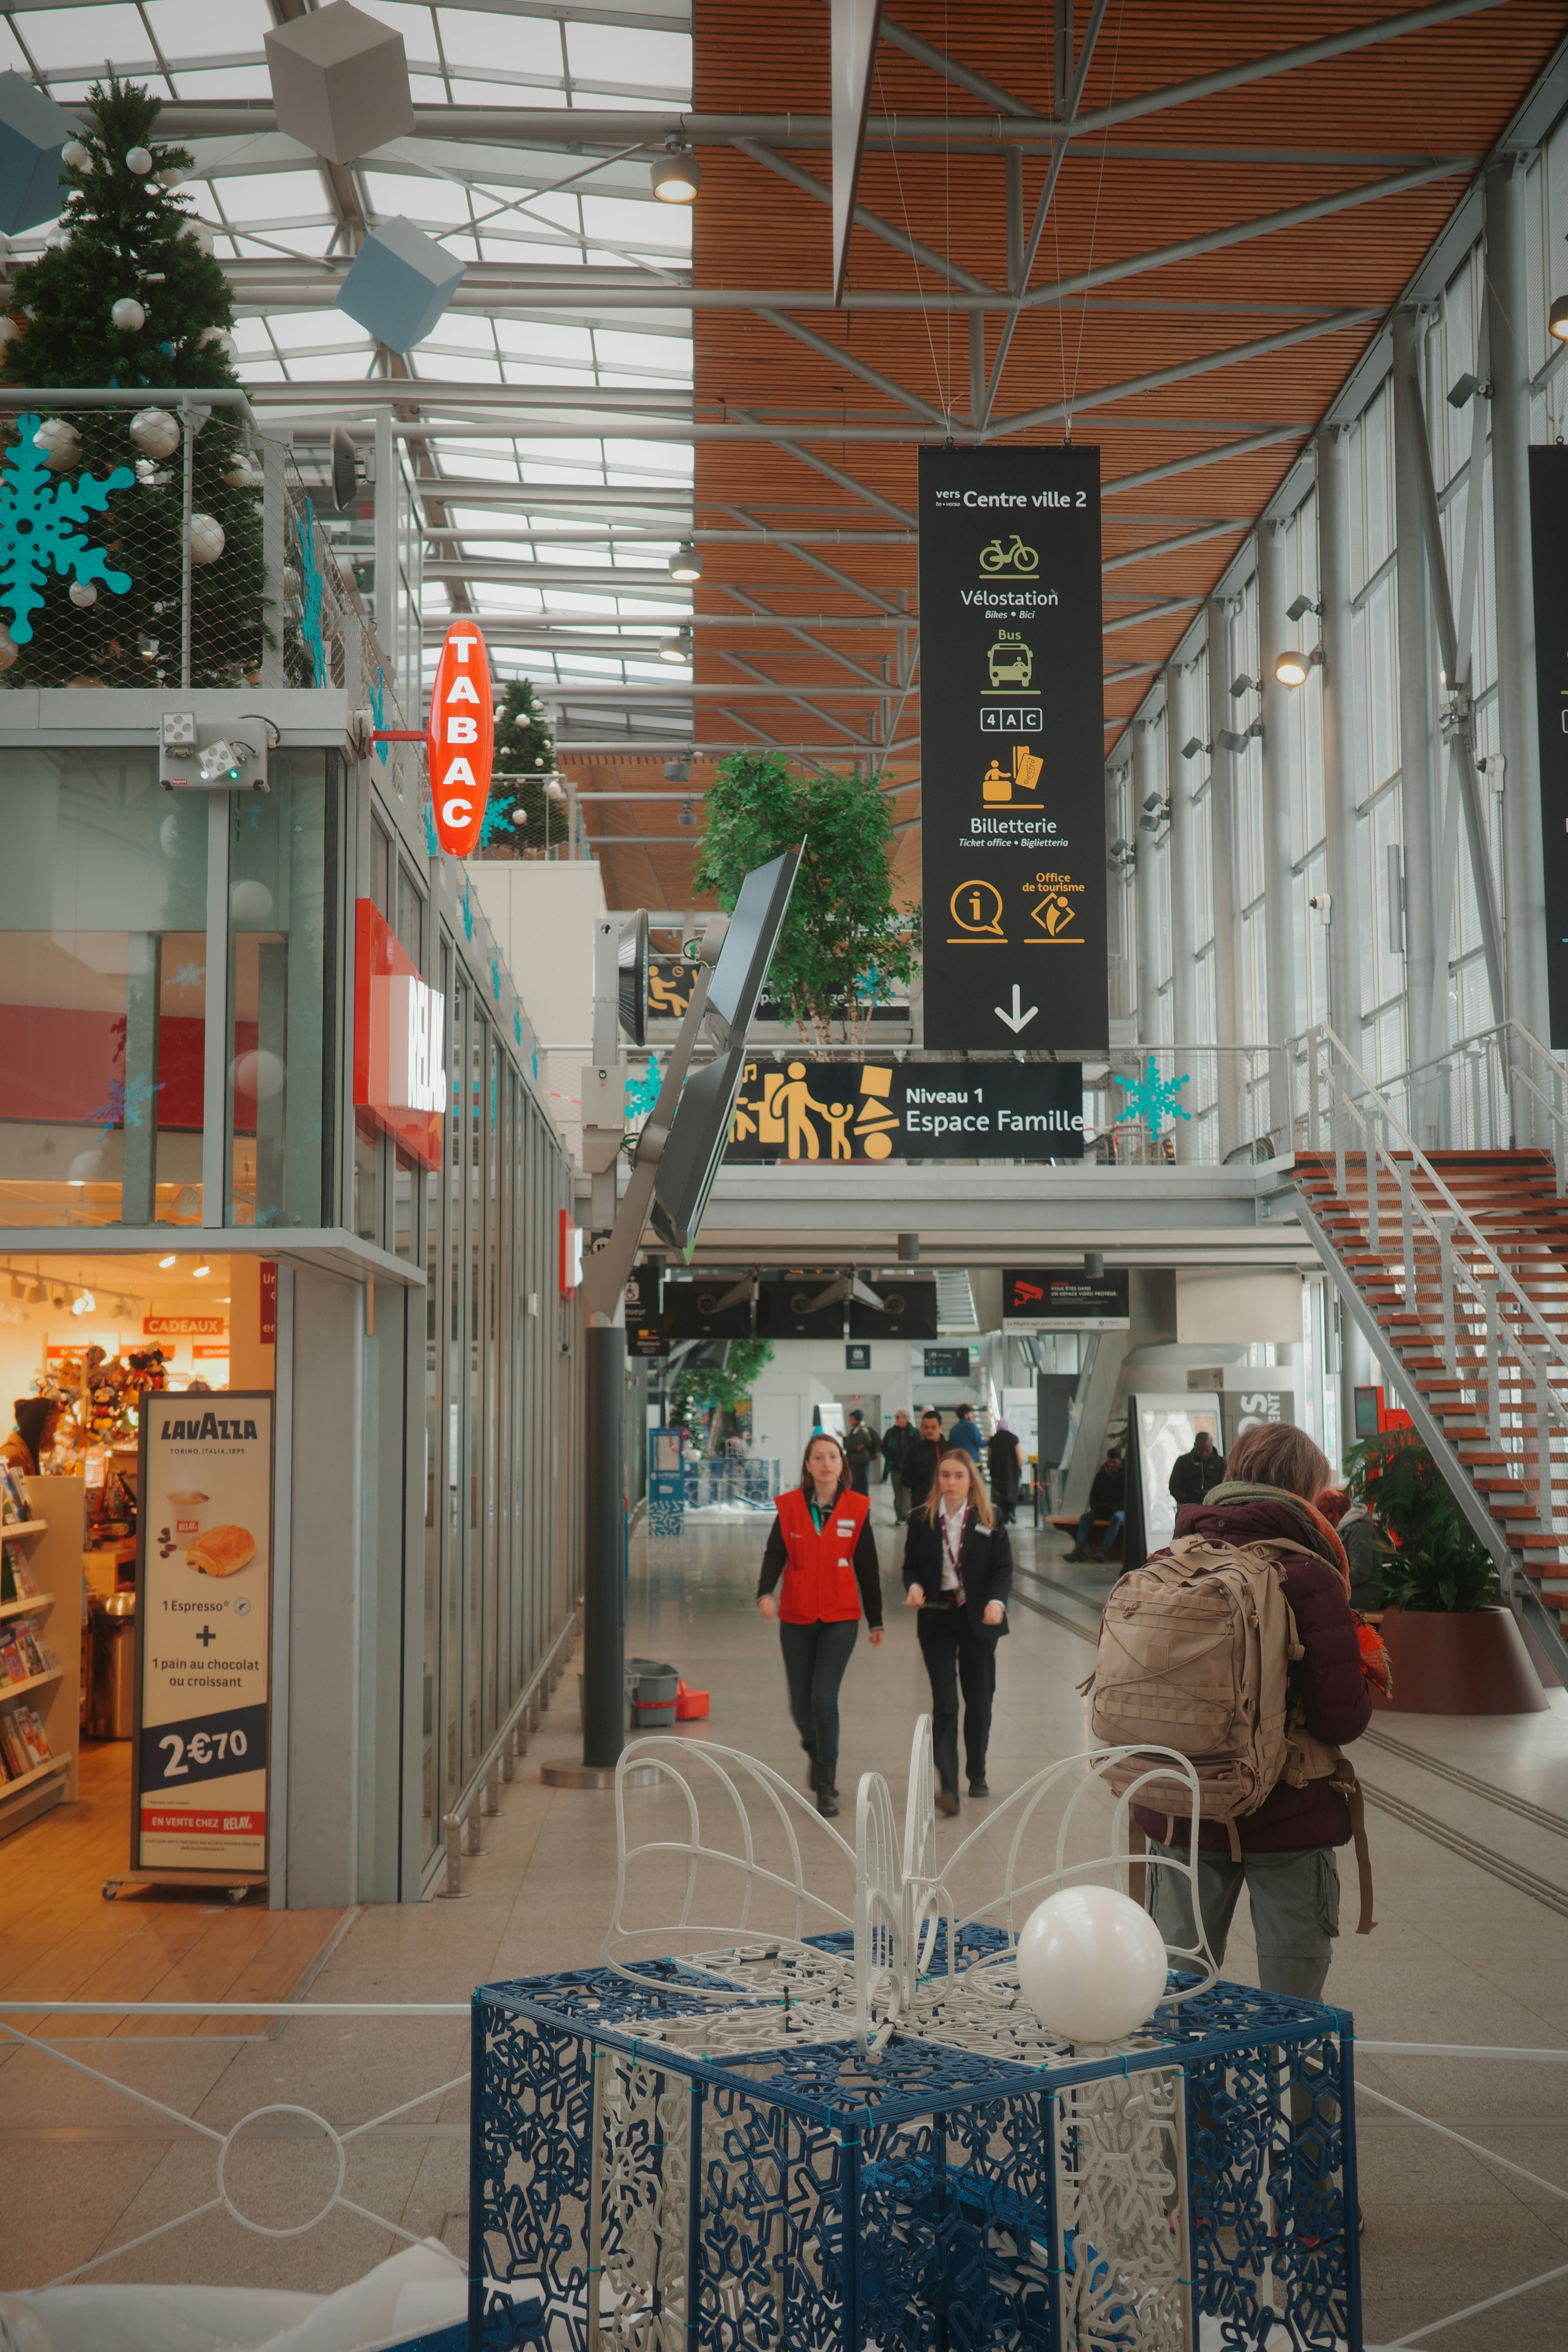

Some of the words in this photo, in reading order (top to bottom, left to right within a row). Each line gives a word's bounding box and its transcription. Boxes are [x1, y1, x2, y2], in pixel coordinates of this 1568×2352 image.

[935, 490, 960, 499] vers
[963, 490, 1027, 507] Centre
[1031, 490, 1071, 507] ville
[1075, 491, 1087, 507] 2
[960, 590, 1058, 606] Vélostation
[985, 610, 1007, 619] Bikes
[1019, 610, 1035, 619] Bici
[998, 629, 1022, 640] Bus
[987, 714, 996, 725] 4
[1006, 714, 1017, 725] A
[1026, 714, 1036, 725] C
[442, 637, 480, 828] TABAC
[971, 818, 1057, 833] Billetterie
[959, 838, 985, 847] Ticket
[987, 838, 1012, 847] office
[1020, 838, 1069, 849] Biglietteria
[1036, 872, 1071, 882] Office
[1022, 882, 1036, 892] de
[1038, 882, 1085, 892] tourisme
[408, 975, 446, 1113] RELAY
[906, 1088, 968, 1104] Niveau
[973, 1088, 983, 1103] 1
[906, 1110, 990, 1137] Espace
[998, 1110, 1084, 1131] Famille
[149, 1319, 218, 1333] CADEAUX
[161, 1412, 258, 1440] LAVAZZA
[162, 1601, 168, 1611] 1
[152, 1658, 158, 1668] 1
[161, 1659, 186, 1671] pain
[190, 1661, 204, 1670] au
[207, 1659, 259, 1670] chocolat
[169, 1677, 184, 1686] ou
[187, 1676, 241, 1687] croissant
[152, 1817, 164, 1826] EN
[165, 1817, 194, 1827] VENTE
[195, 1818, 219, 1828] CHEZ
[223, 1816, 251, 1831] RELAY
